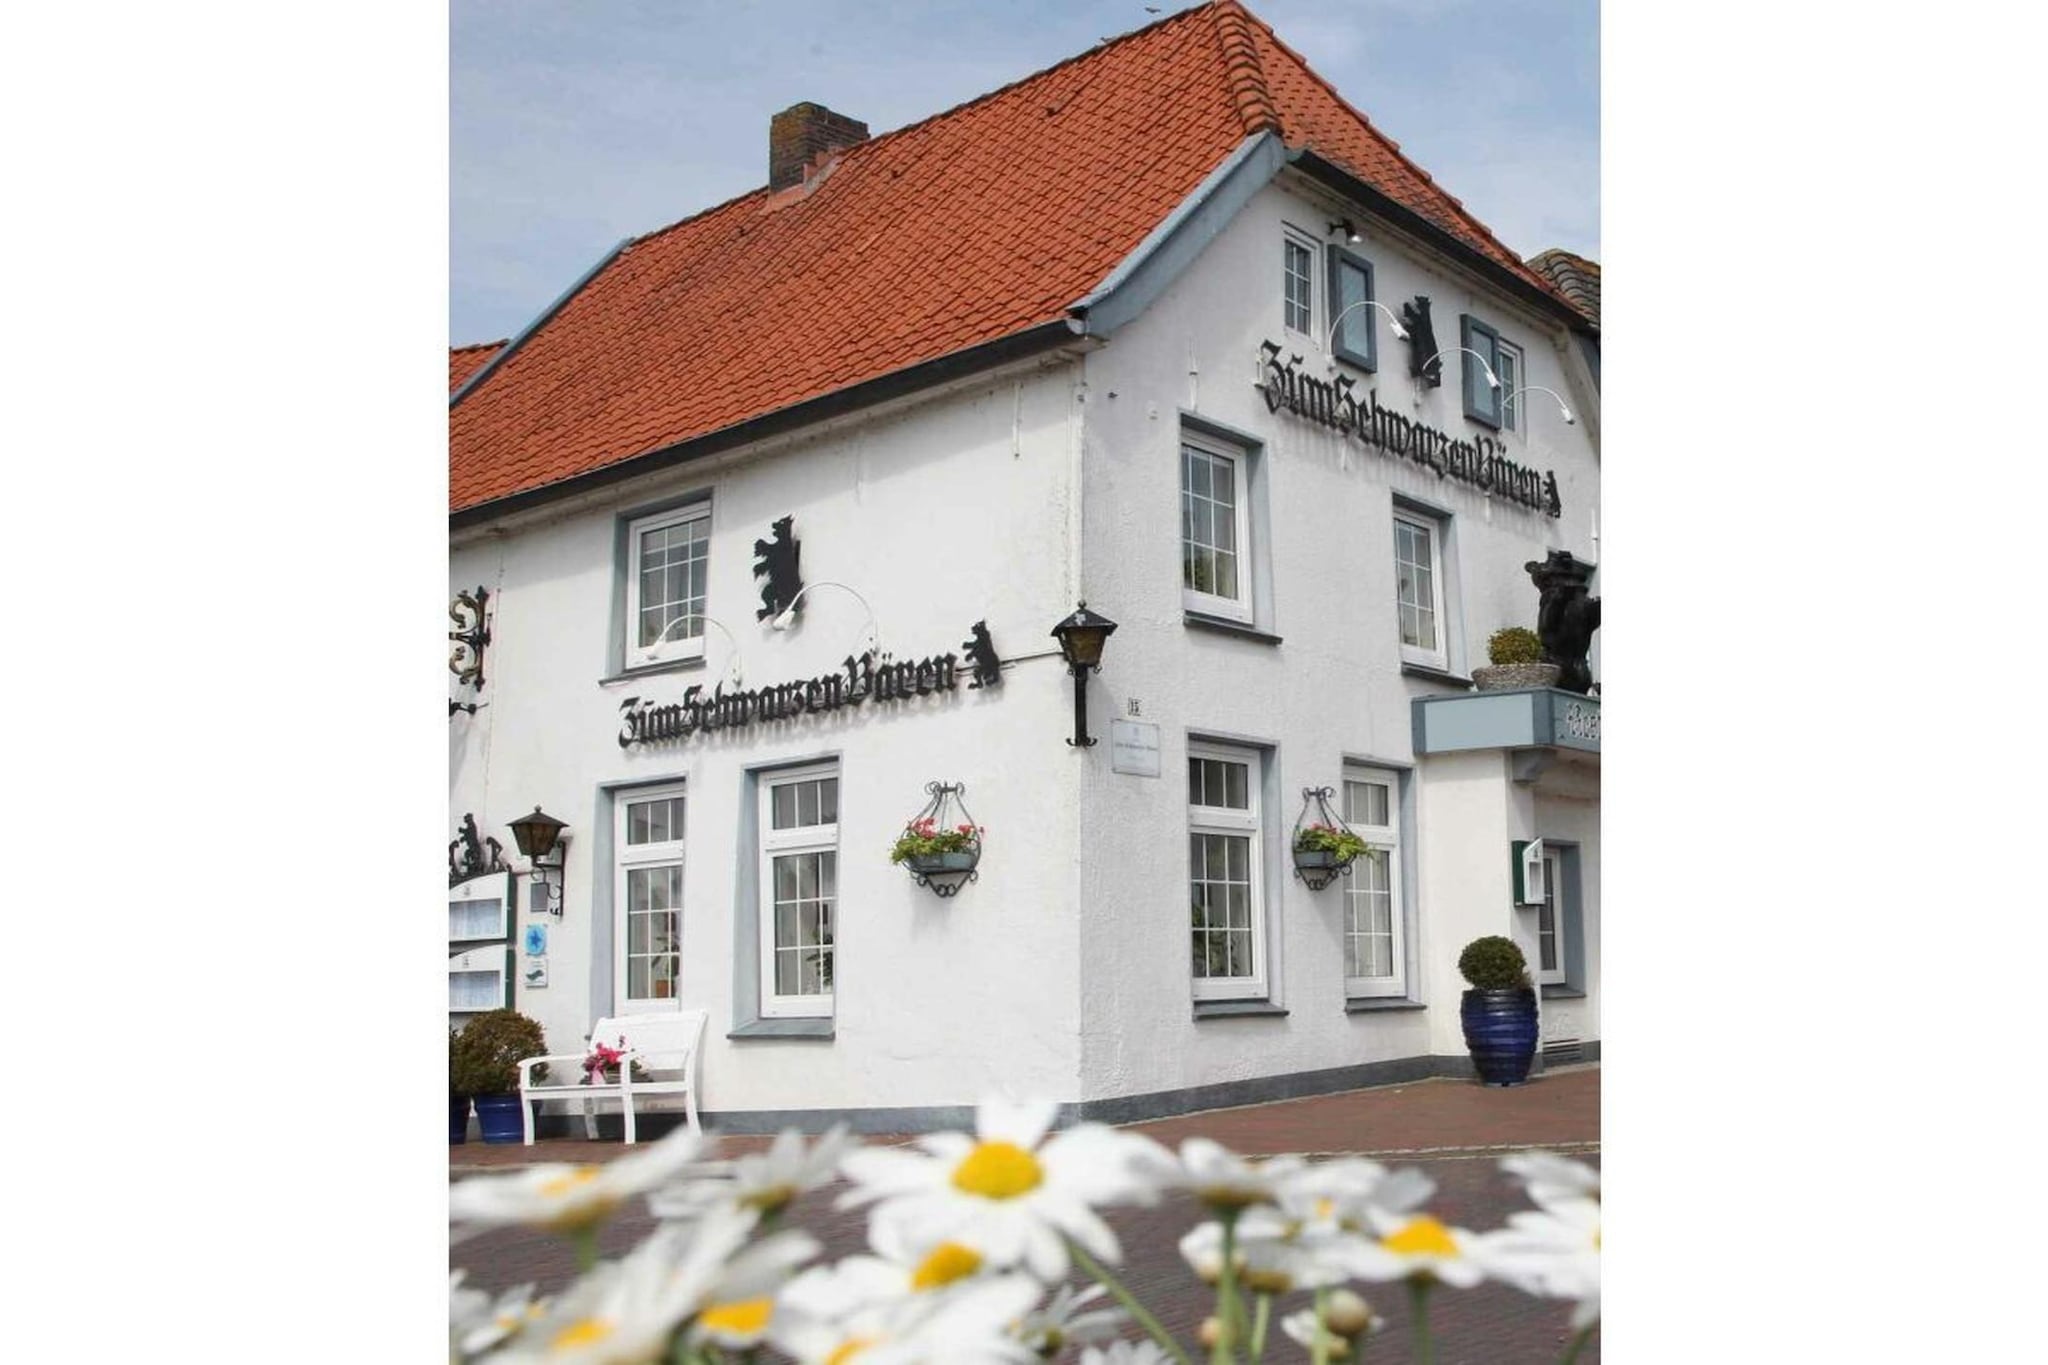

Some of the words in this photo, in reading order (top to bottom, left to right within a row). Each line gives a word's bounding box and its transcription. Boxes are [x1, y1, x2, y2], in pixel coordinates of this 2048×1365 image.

[1334, 373, 1474, 484] Schwarzen
[1474, 434, 1541, 511] Bären
[680, 671, 843, 733] Schwarzen
[841, 650, 959, 705] Bären
